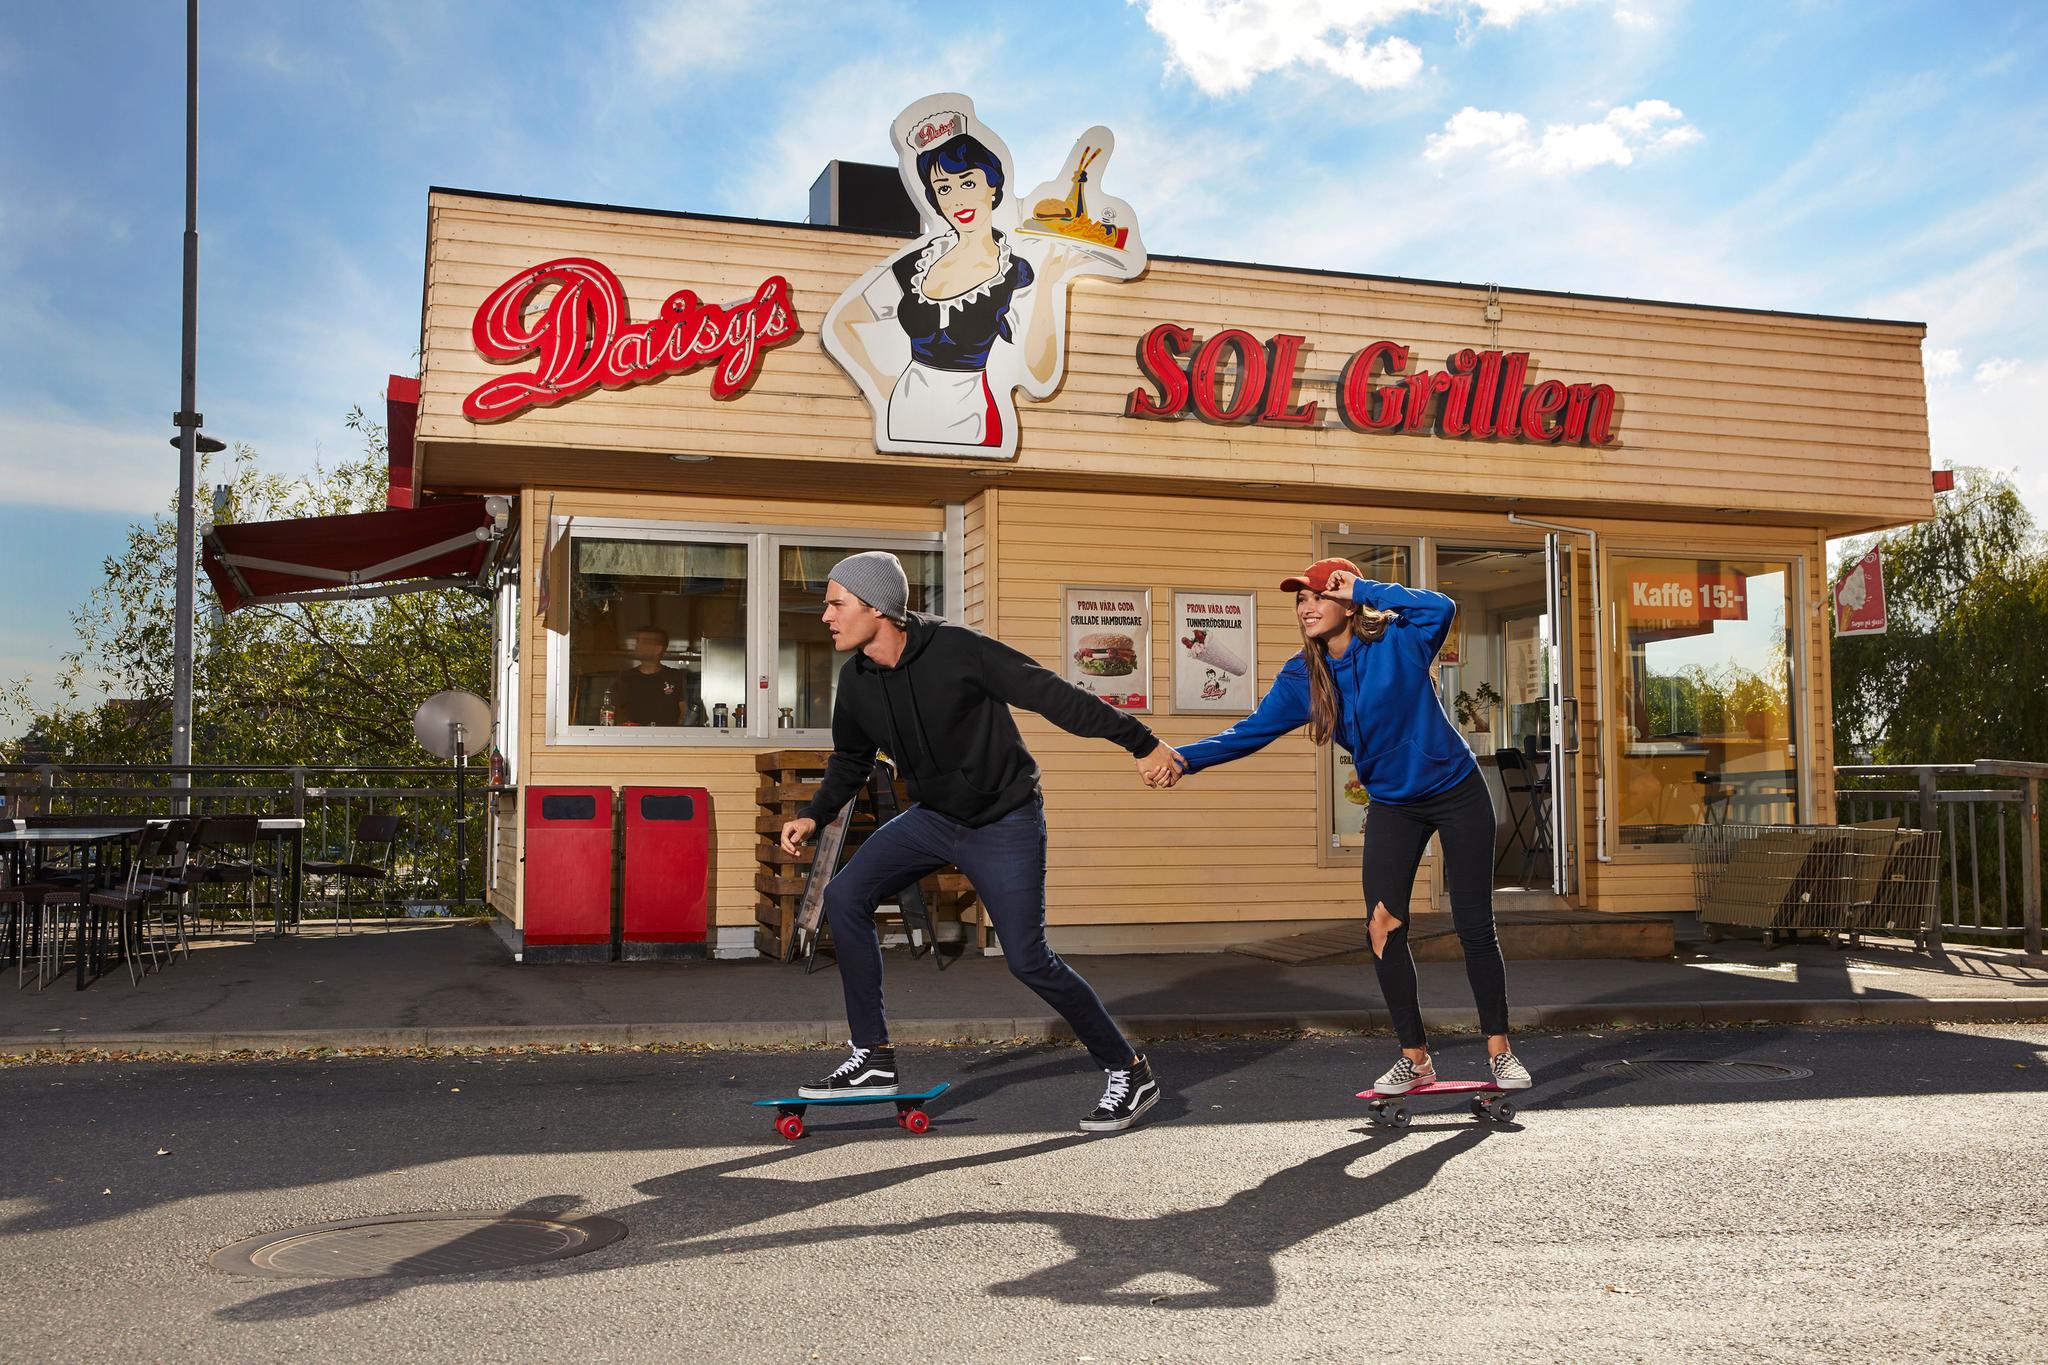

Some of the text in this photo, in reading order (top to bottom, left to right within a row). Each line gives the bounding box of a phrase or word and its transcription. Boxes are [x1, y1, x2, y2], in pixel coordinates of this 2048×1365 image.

[463, 257, 798, 421] Daisy's
[1127, 323, 1616, 446] SOL Grillen
[1632, 582, 1744, 609] Kaffe 15:-
[1077, 601, 1098, 611] PROVA
[1117, 601, 1135, 612] GODA
[1186, 603, 1206, 614] PROVA
[1224, 605, 1241, 615] GODA
[1070, 615, 1142, 626] GRILLADE HAMBURGARE
